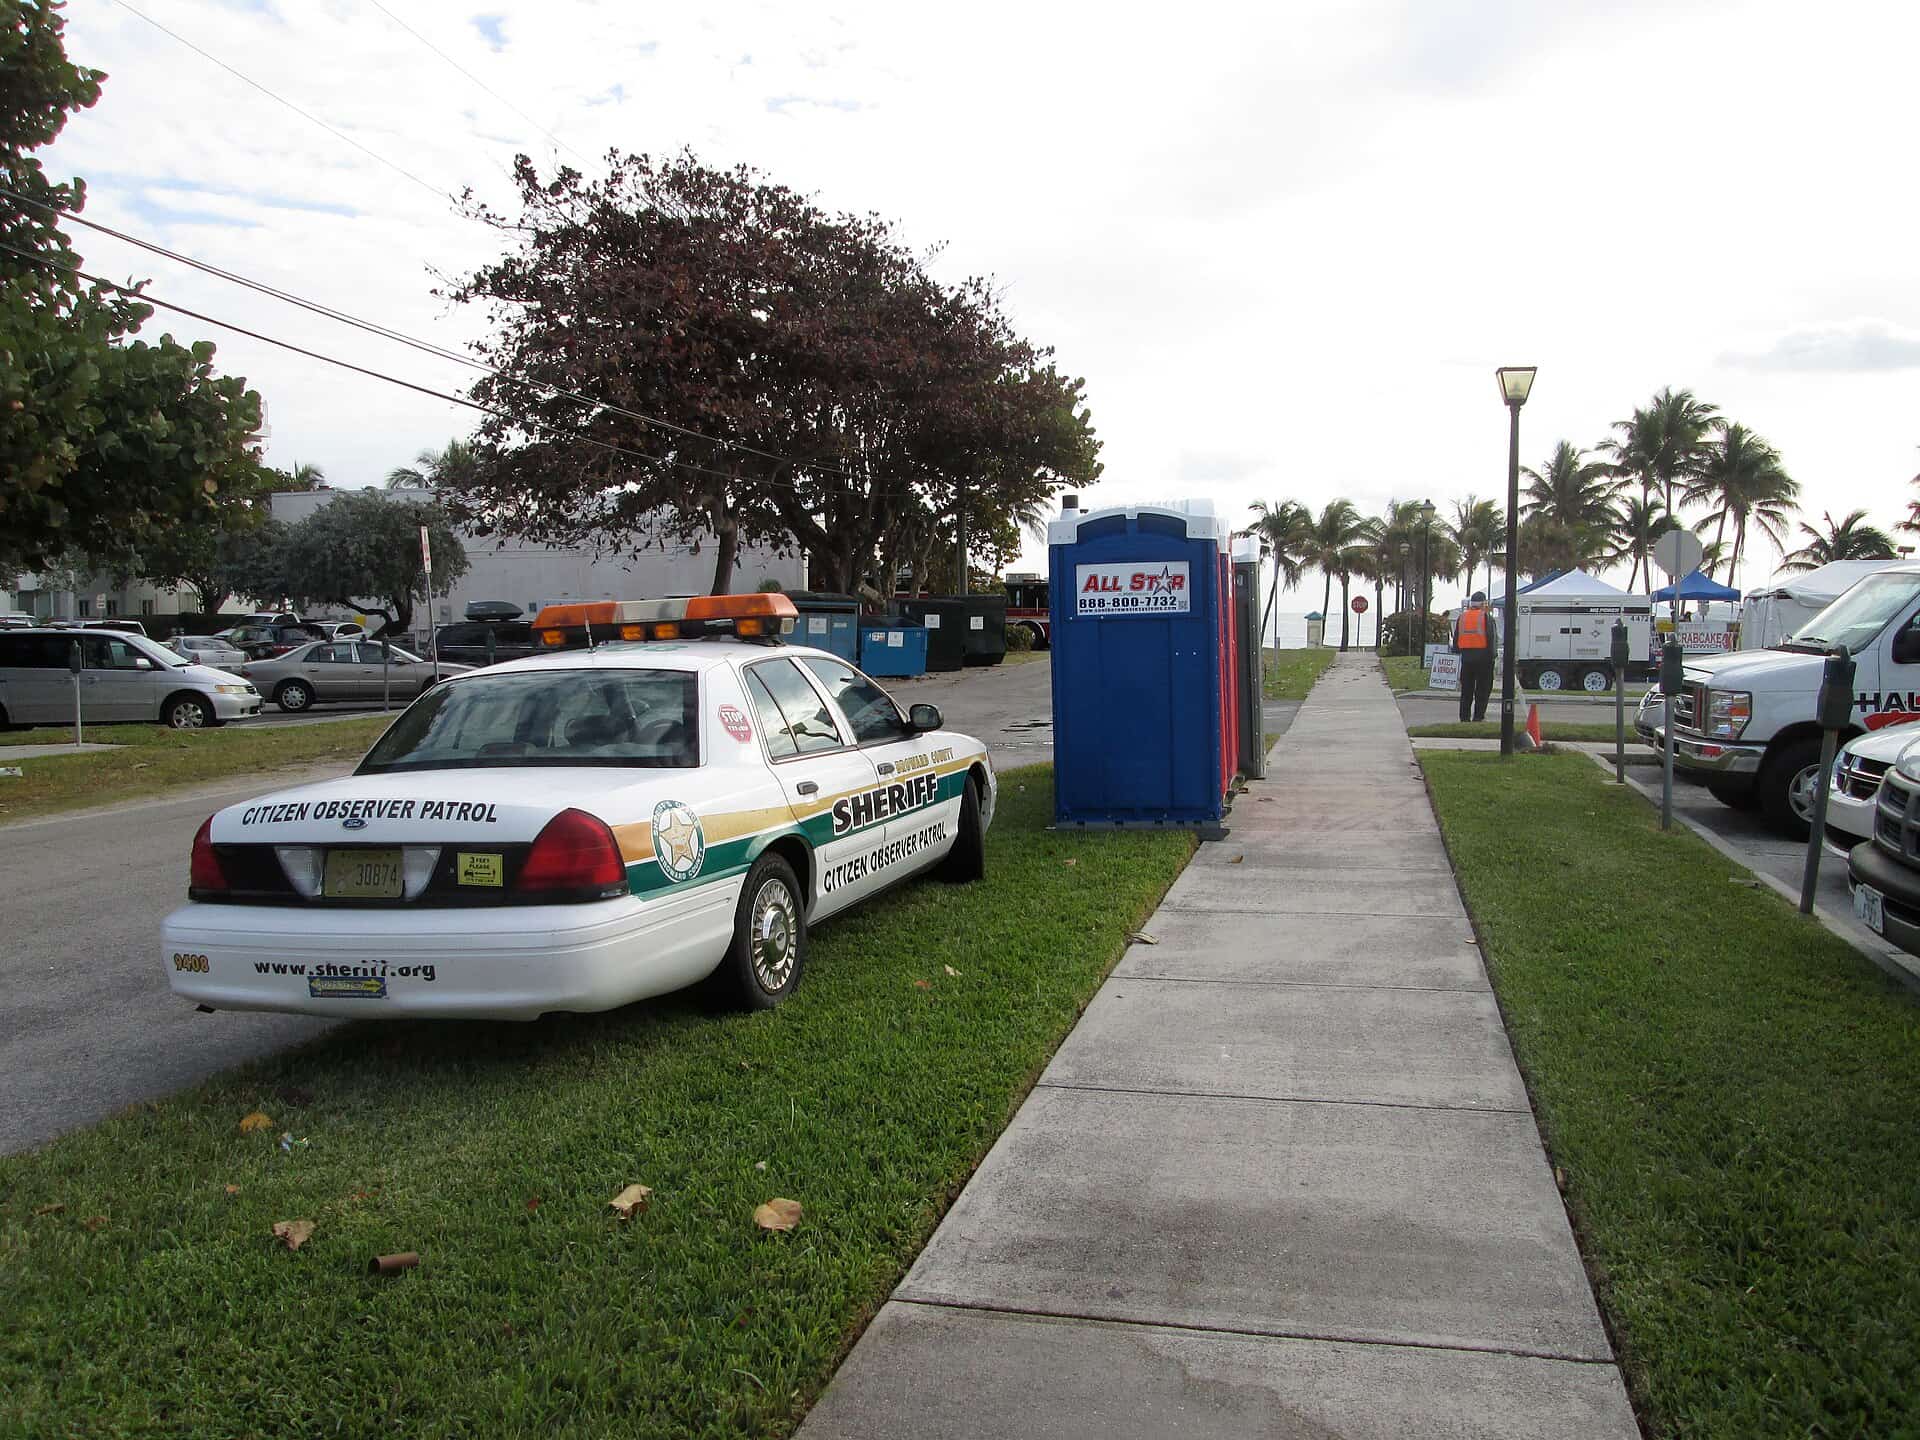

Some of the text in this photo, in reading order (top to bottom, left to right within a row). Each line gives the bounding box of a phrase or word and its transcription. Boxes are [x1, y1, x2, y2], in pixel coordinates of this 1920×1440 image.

[1081, 573, 1123, 593] ALL
[1079, 596, 1177, 609] 888-800-7732
[242, 799, 498, 826] CITIZEN OBSERVER PATROL
[832, 772, 938, 834] SHERIFF
[823, 821, 947, 893] CITIZEN OBSERVER PATROL
[355, 863, 398, 886] 30874
[174, 953, 210, 973] 9408
